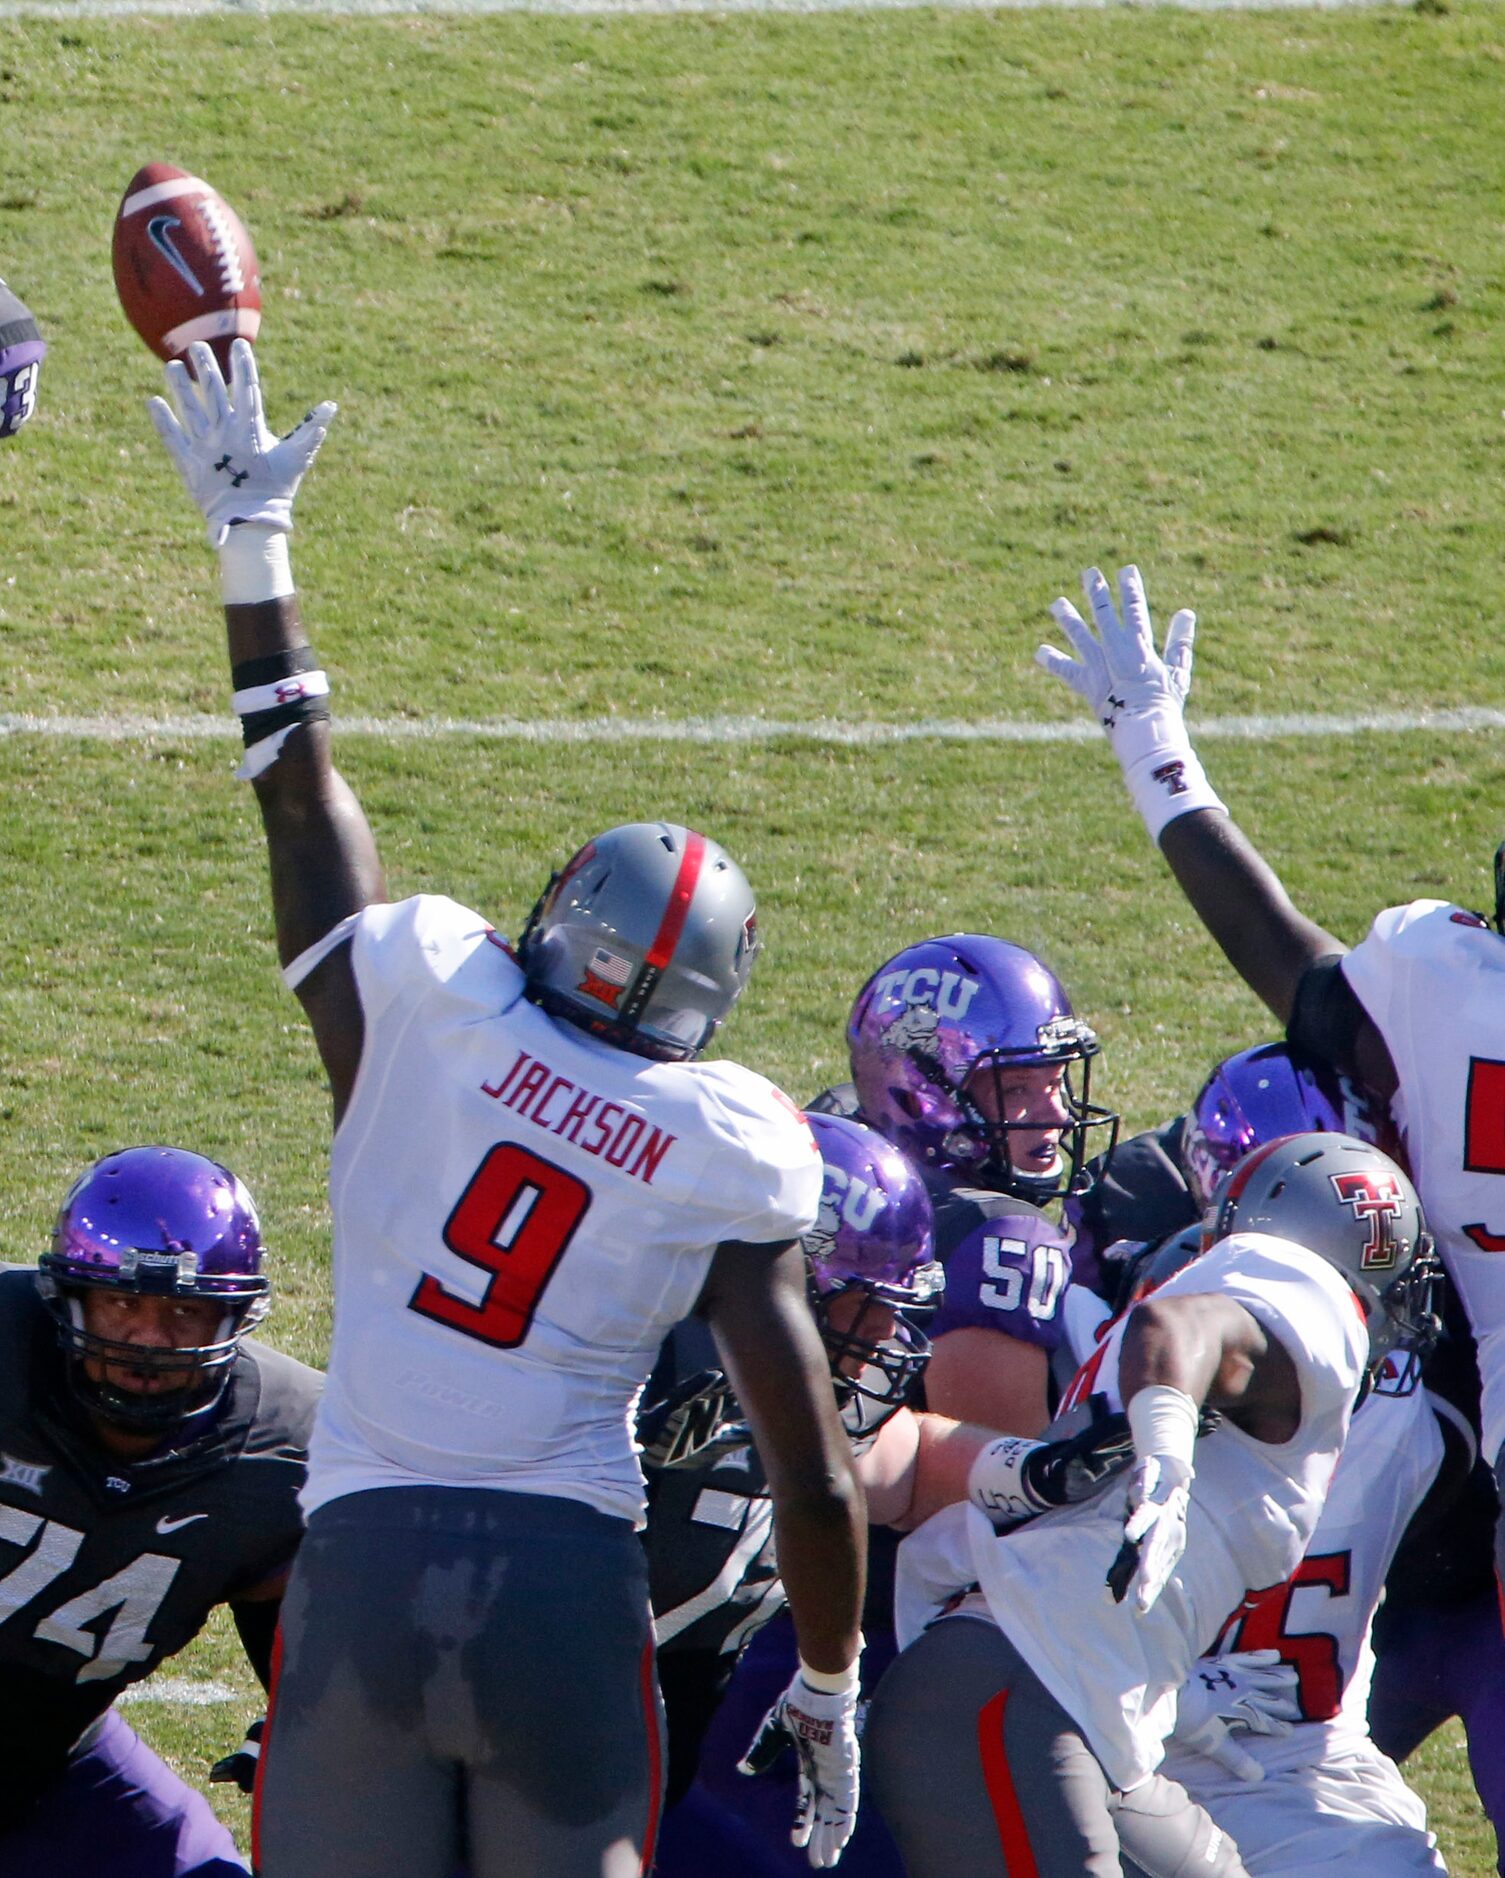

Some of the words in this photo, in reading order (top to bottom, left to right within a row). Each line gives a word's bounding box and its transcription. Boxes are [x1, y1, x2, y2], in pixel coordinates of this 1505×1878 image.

[876, 967, 980, 1021] TCU
[481, 1050, 678, 1185] JACKSON
[822, 1163, 888, 1232] CU
[407, 1141, 593, 1350] 9
[979, 1236, 1065, 1321] 50
[106, 1476, 131, 1493] TCU
